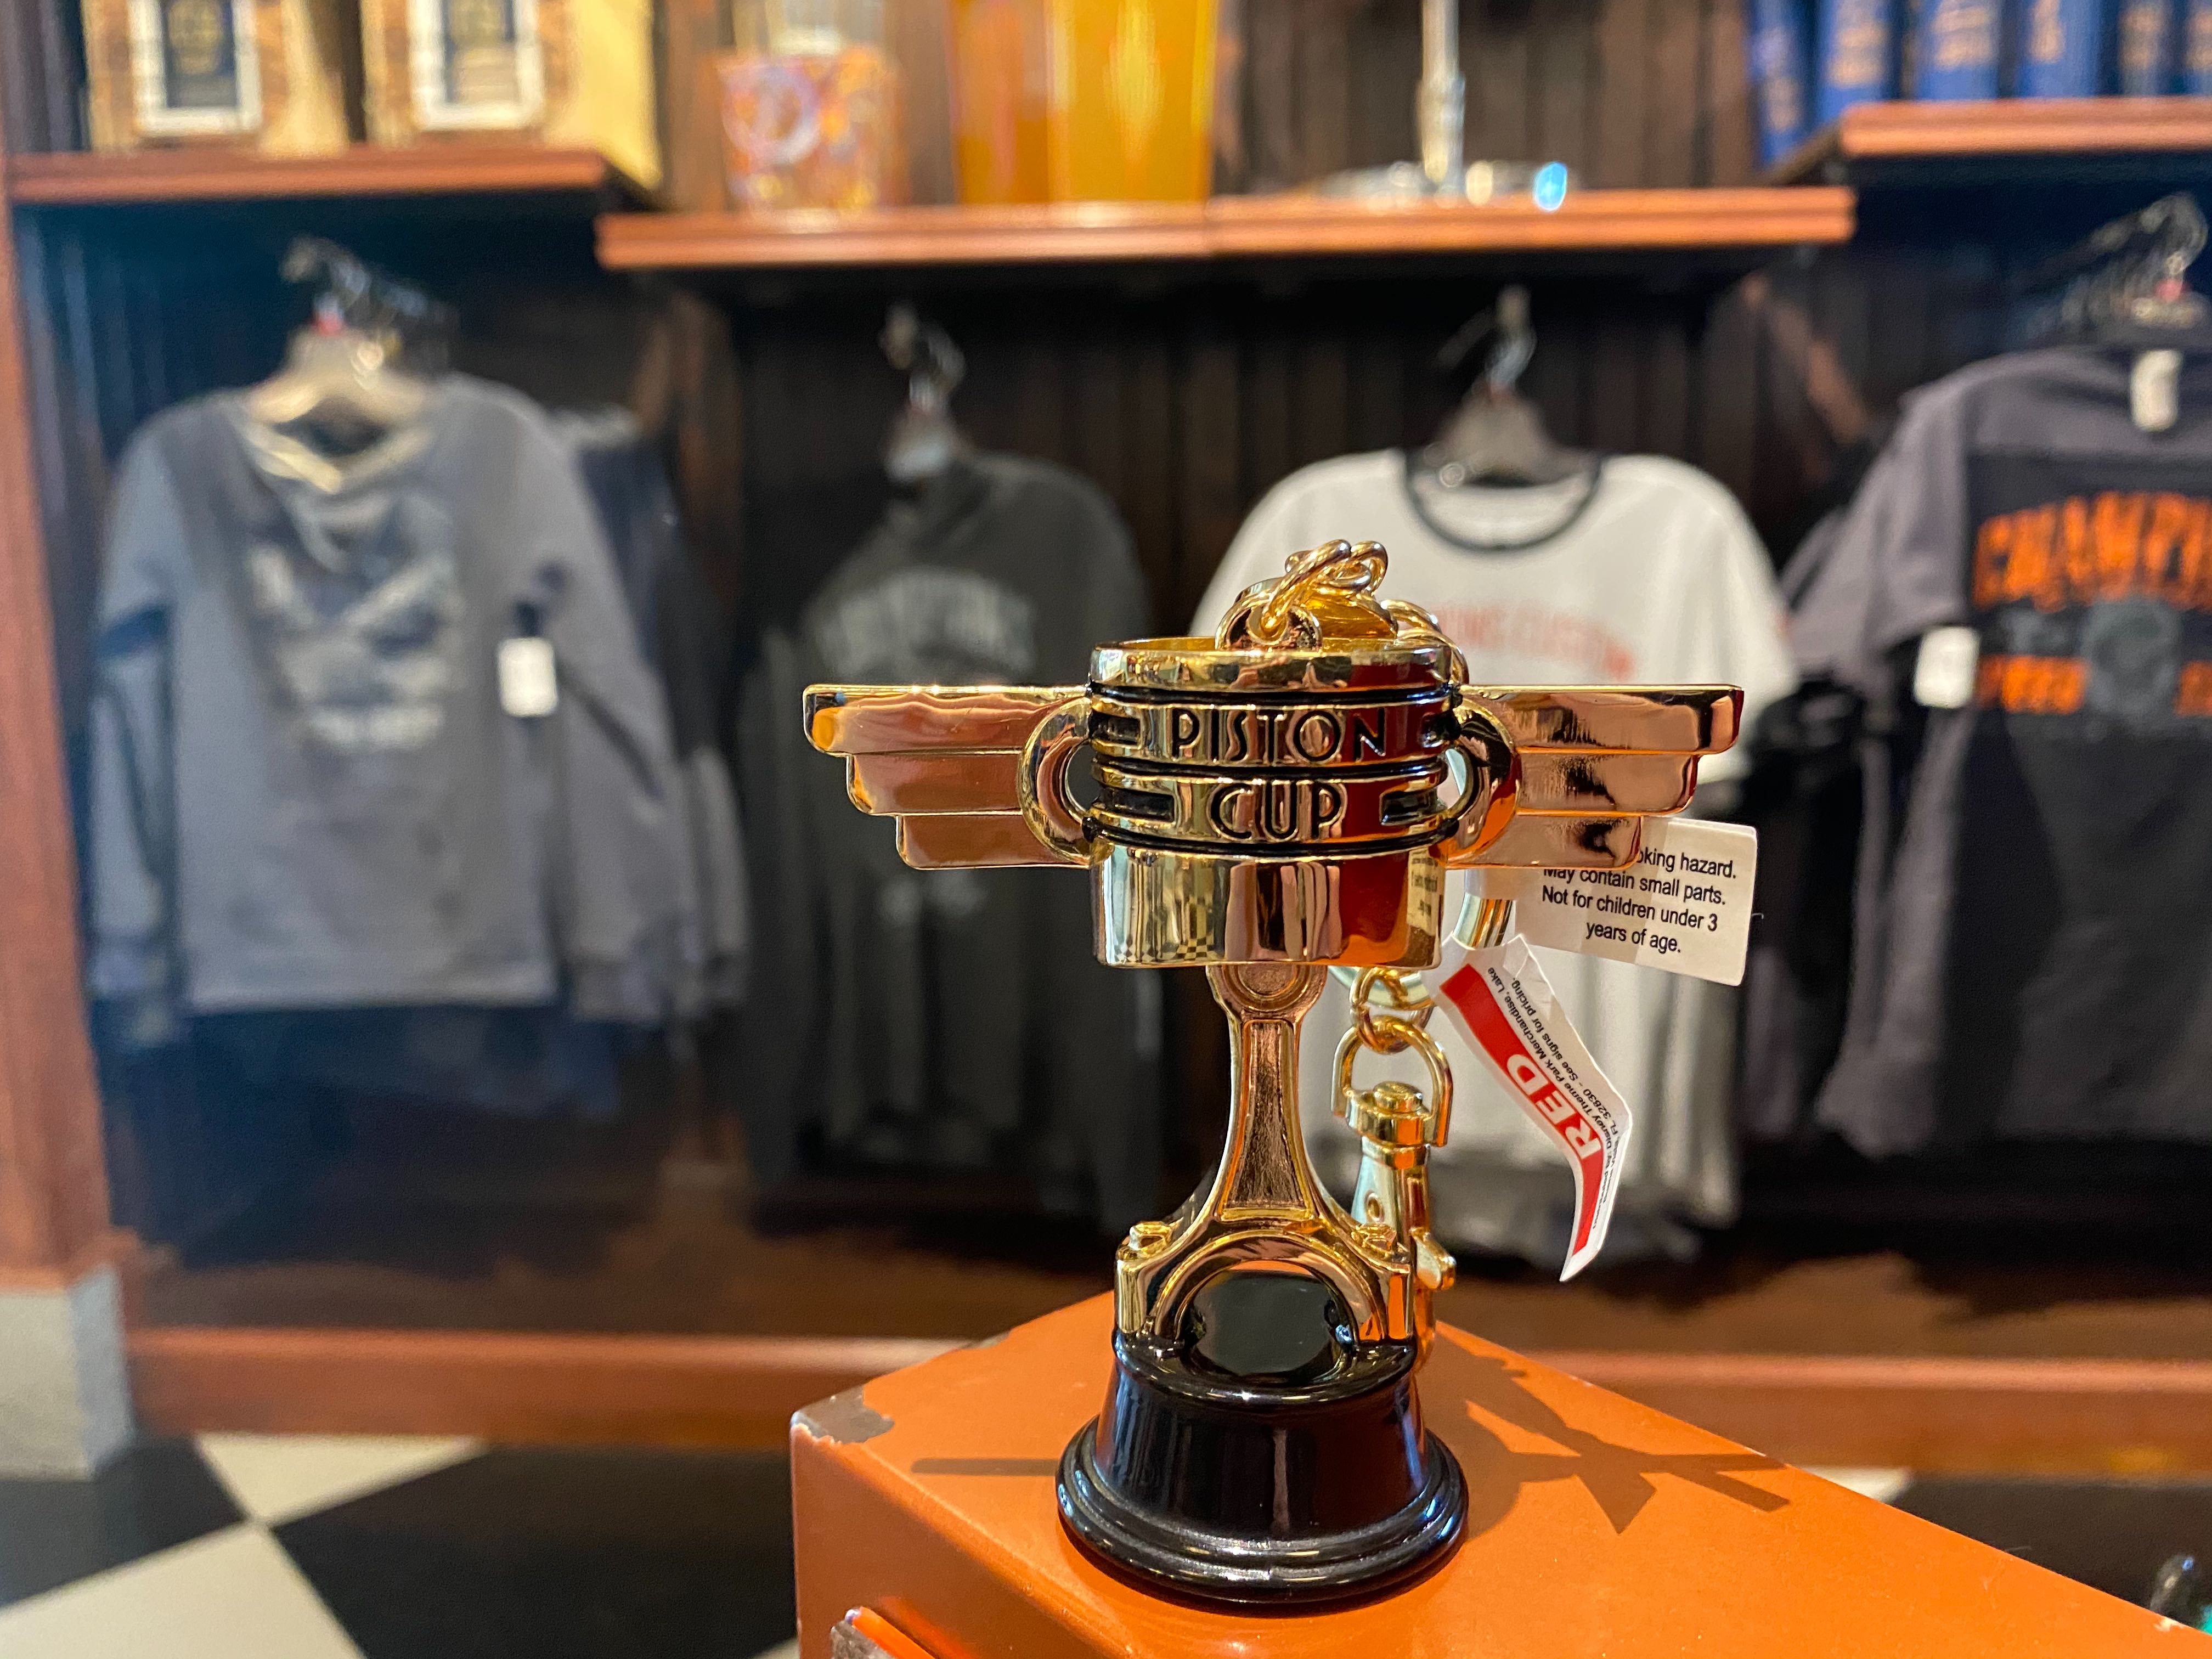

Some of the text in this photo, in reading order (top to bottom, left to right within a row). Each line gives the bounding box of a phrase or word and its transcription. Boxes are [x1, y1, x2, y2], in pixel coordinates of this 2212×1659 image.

[1171, 707, 1386, 764] PISTON
[1210, 780, 1345, 842] CUP
[1636, 847, 1736, 879] oking hazard.
[1579, 870, 1635, 889] contain
[1639, 878, 1680, 897] small
[1683, 885, 1726, 905] parts.
[1542, 884, 1718, 932] Not for children under 3
[1585, 922, 1681, 954] years of age.
[1487, 967, 1505, 993] Lake
[1511, 977, 1537, 1017] pricing.
[1504, 991, 1547, 1060] Merchandise,
[1531, 1018, 1544, 1034] for
[1542, 1032, 1563, 1060] signs
[1544, 1059, 1565, 1082] Park
[1561, 1061, 1578, 1082] See
[1506, 1053, 1601, 1160] RED
[1564, 1082, 1593, 1115] Theme
[1583, 1088, 1612, 1120] 32830
[1592, 1115, 1612, 1149] Disney
[1610, 1119, 1619, 1136] FL
